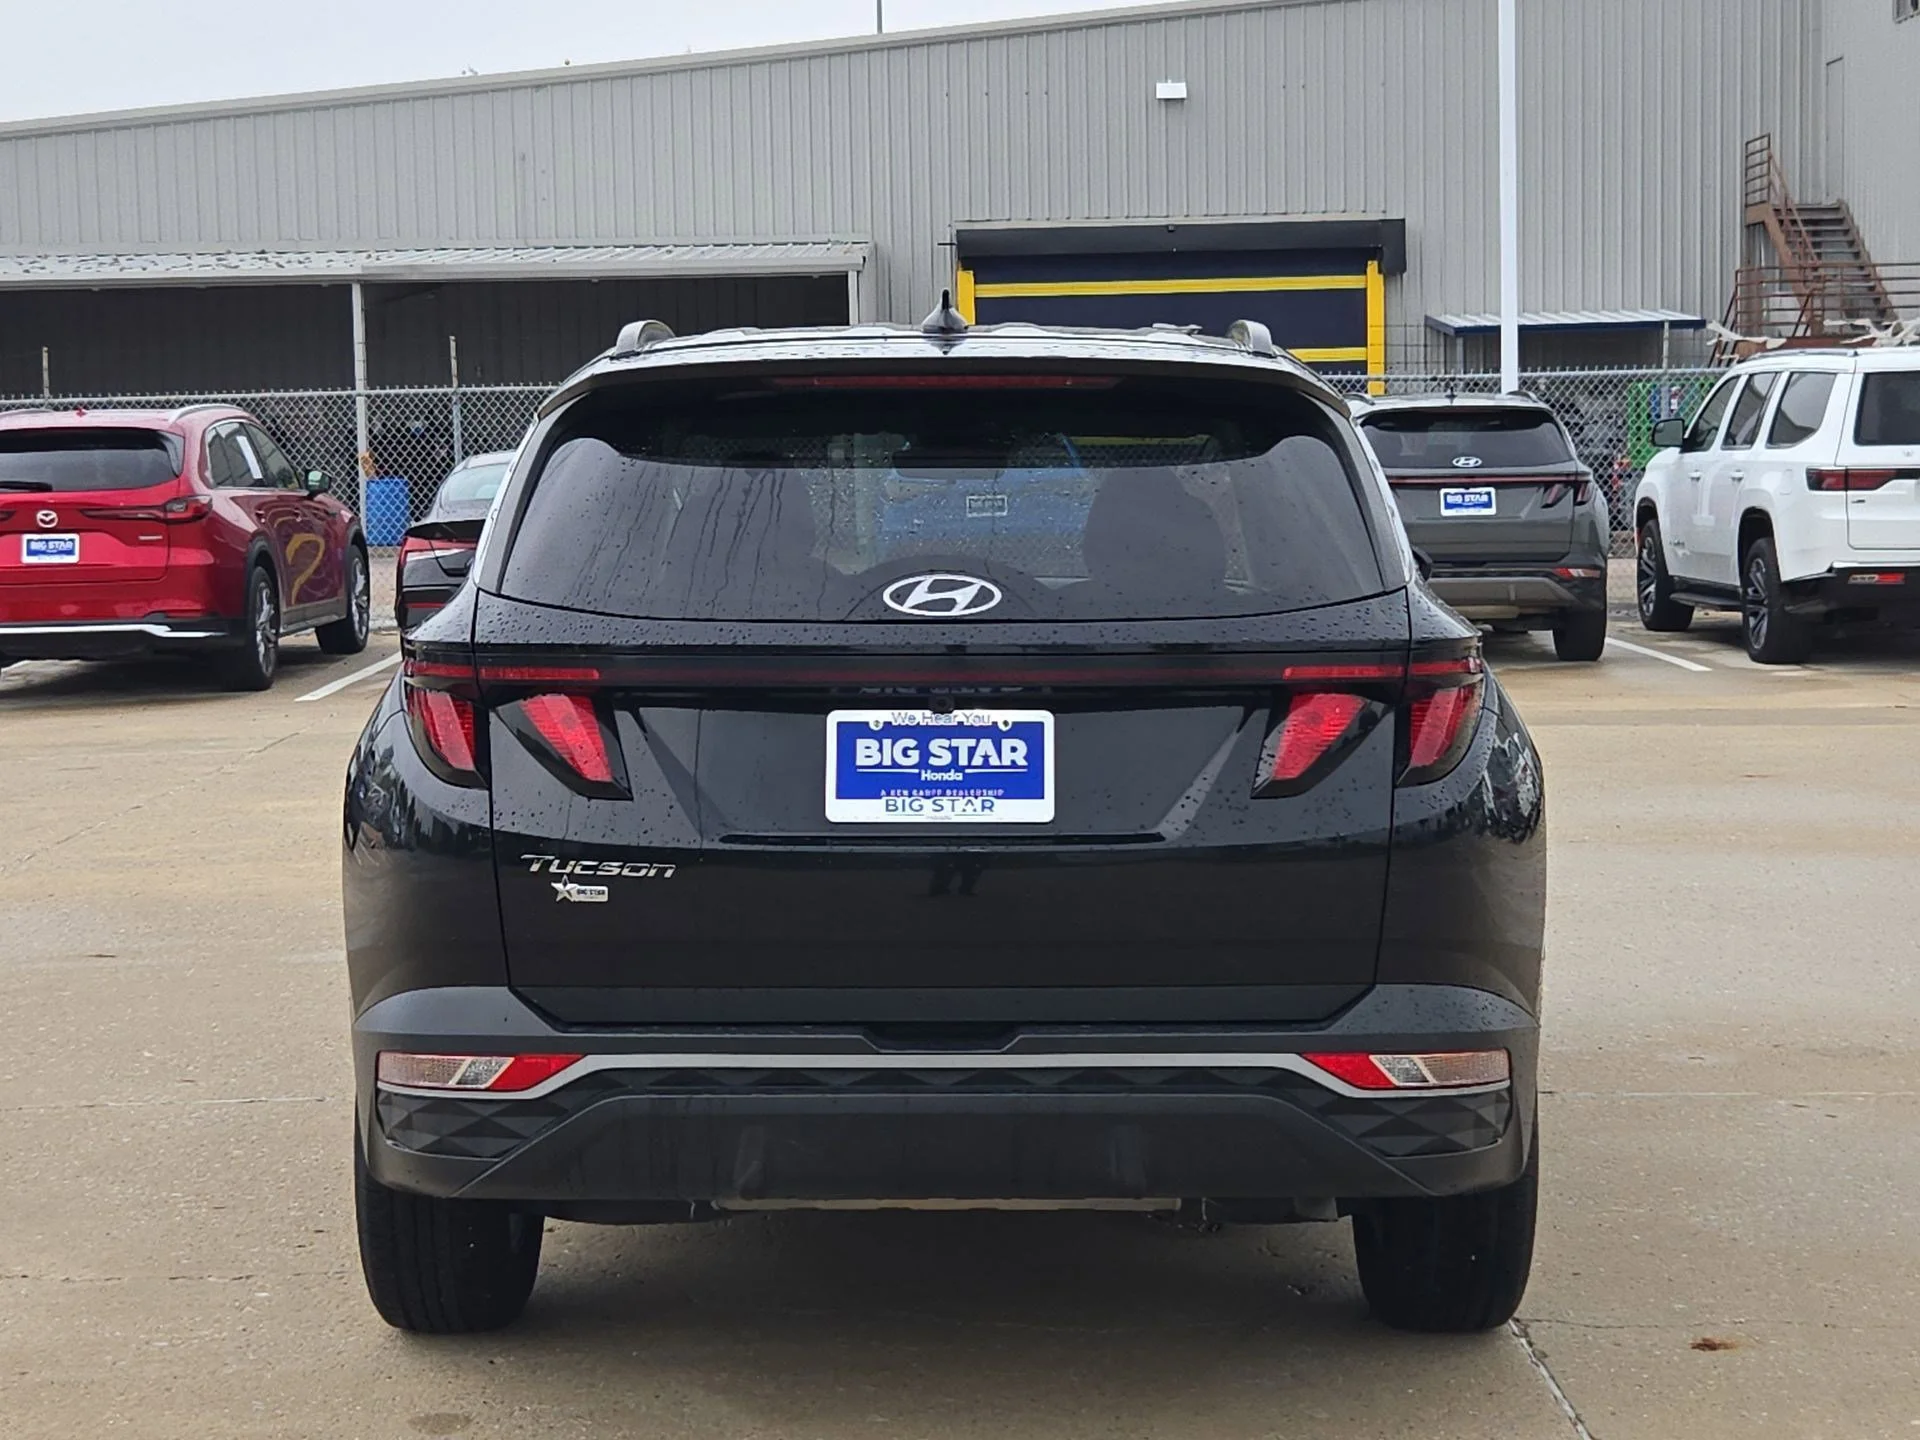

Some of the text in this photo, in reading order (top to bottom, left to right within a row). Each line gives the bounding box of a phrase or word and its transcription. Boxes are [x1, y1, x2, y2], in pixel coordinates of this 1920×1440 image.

[30, 541, 73, 551] BIG STAR
[891, 712, 991, 724] We Hear You
[855, 738, 1029, 767] BIG STAR
[920, 768, 964, 781] Honda
[885, 798, 995, 813] BIG STAR
[520, 854, 677, 879] TUCSON
